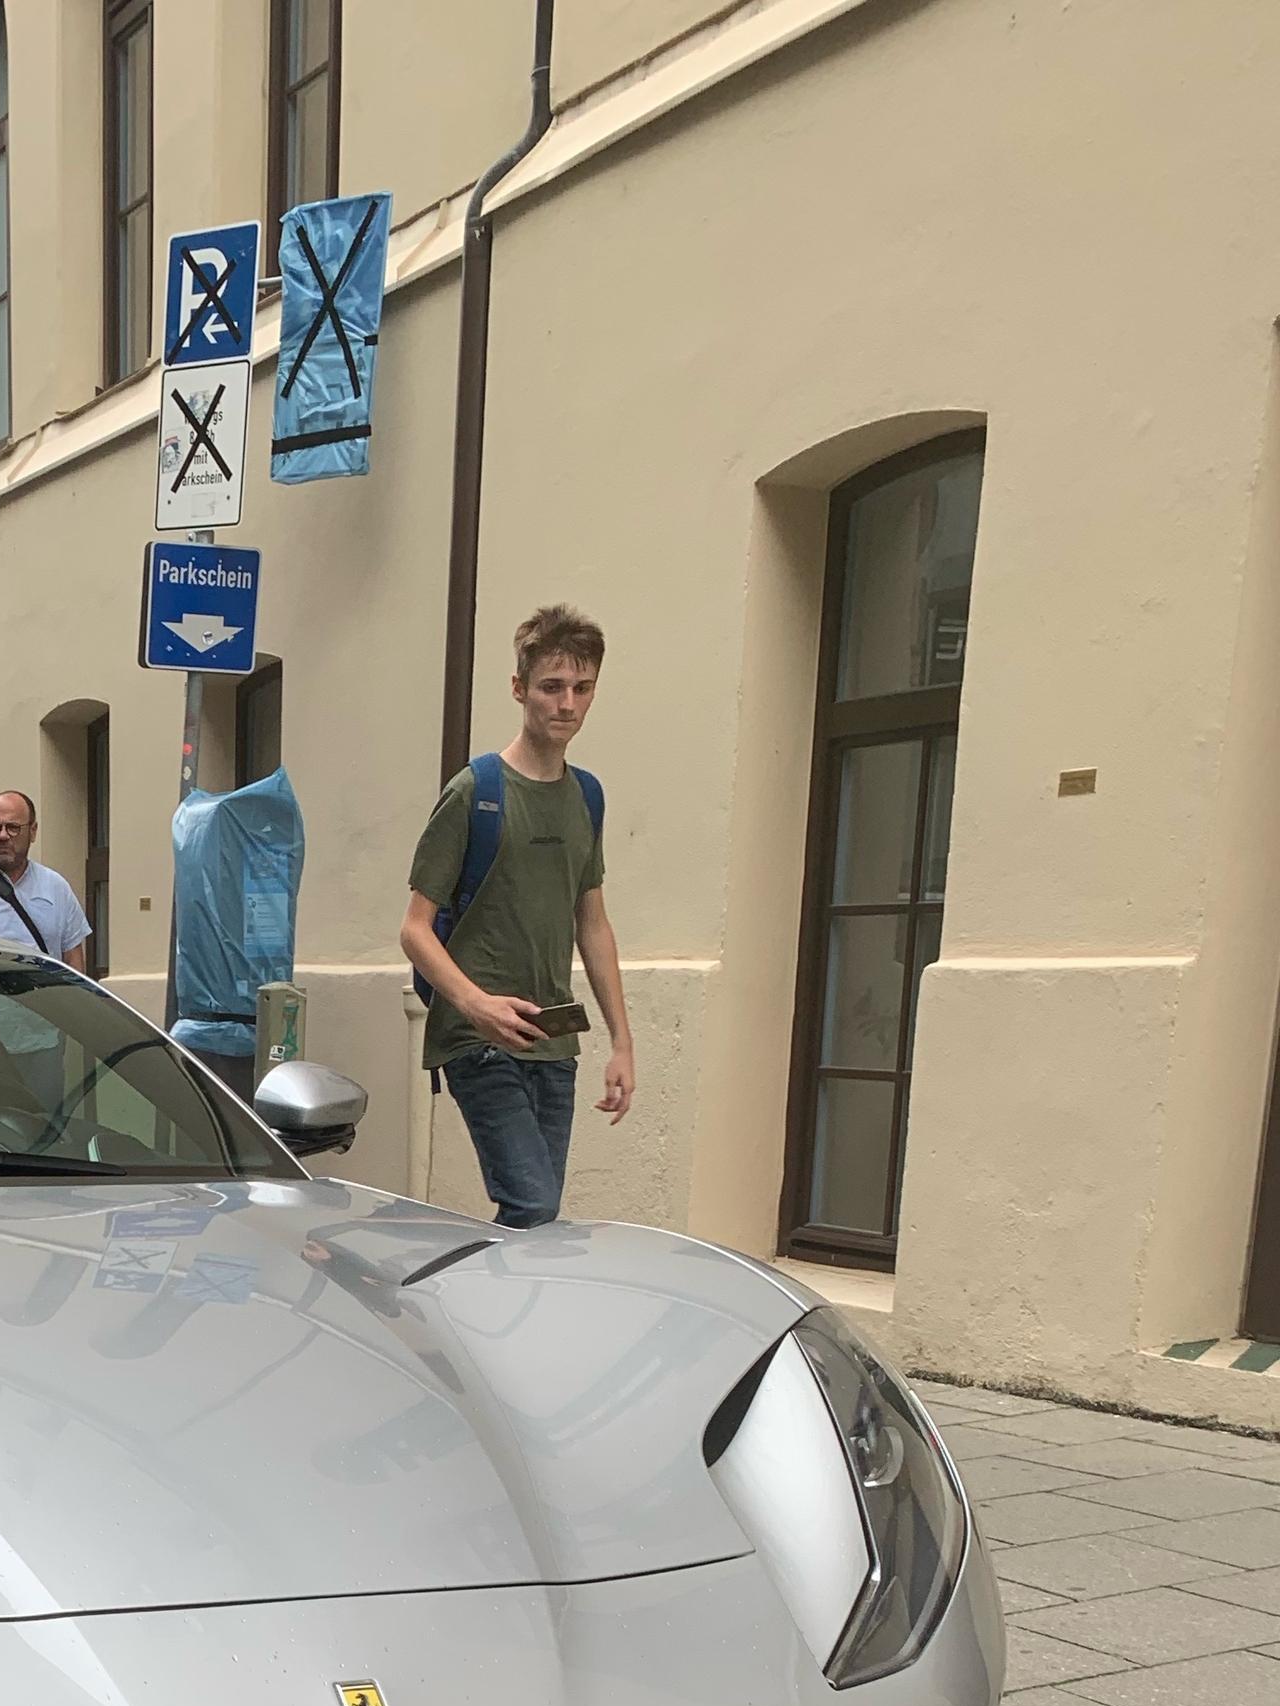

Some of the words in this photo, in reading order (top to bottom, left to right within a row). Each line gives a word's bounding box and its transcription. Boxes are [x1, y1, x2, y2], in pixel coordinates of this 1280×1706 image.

[193, 450, 208, 465] mit
[180, 470, 223, 487] arkschein
[159, 559, 252, 589] Parkschein
